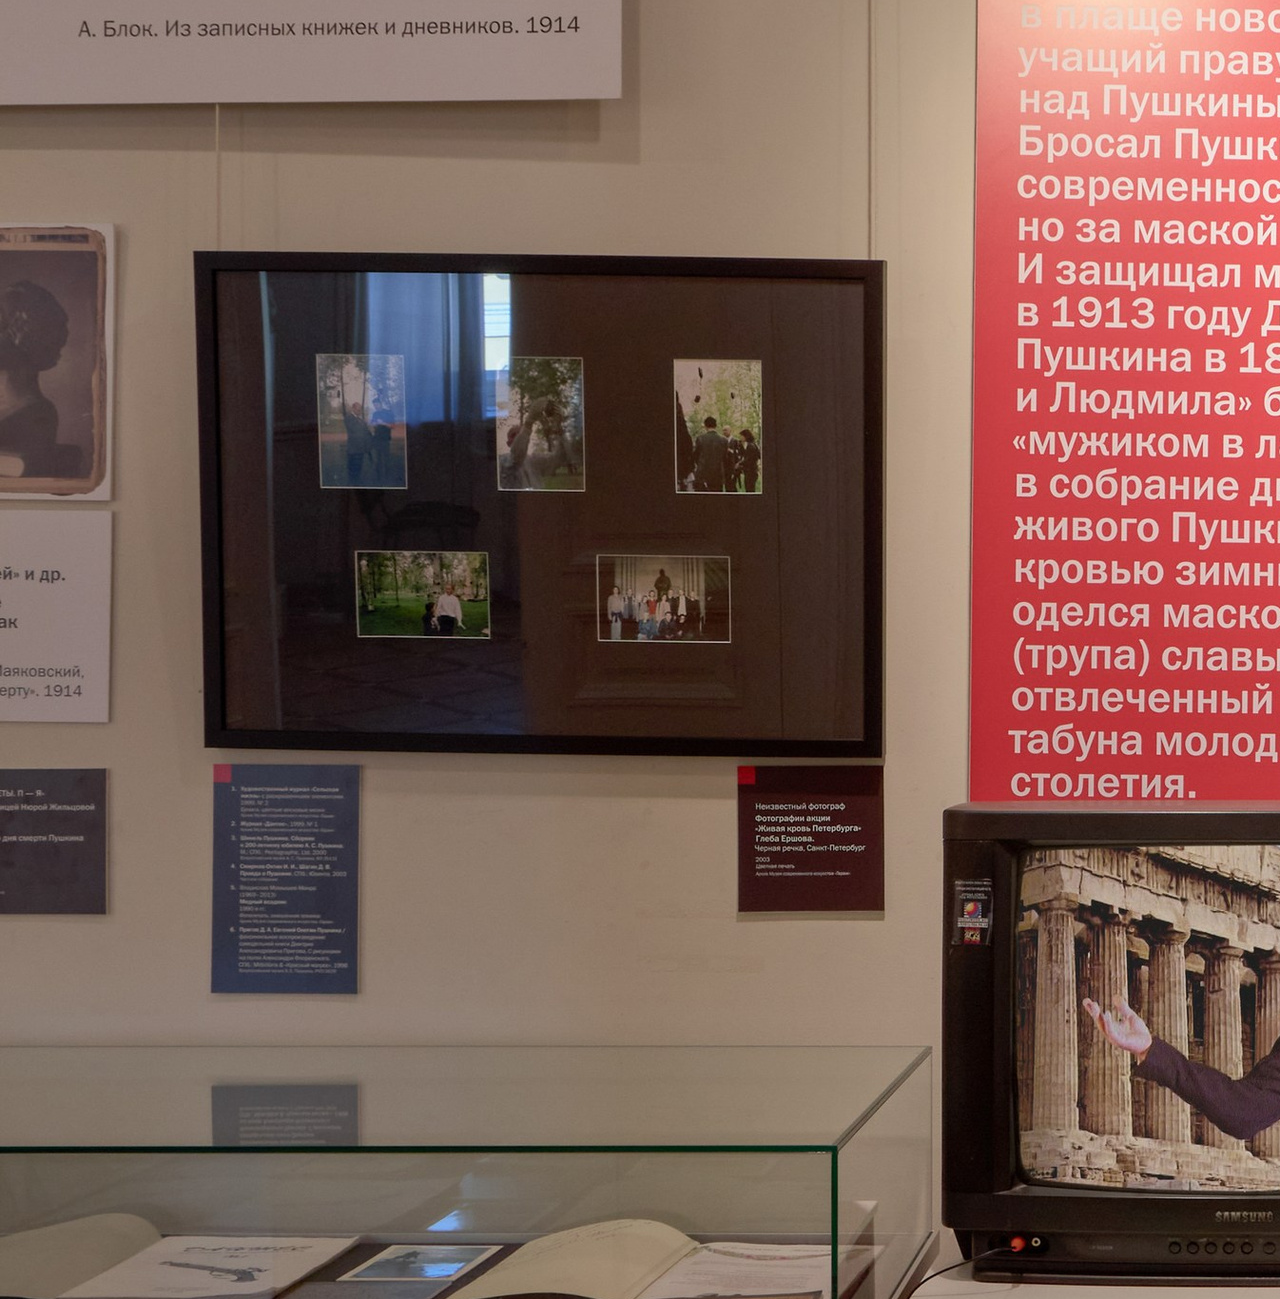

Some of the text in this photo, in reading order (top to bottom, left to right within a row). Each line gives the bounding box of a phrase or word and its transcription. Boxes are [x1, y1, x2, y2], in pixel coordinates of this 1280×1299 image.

[78, 16, 580, 38] А. Блок. Из записных книжек и дневников. 1914
[1019, 43, 1165, 77] учащий
[1021, 90, 1090, 120] над
[1020, 125, 1160, 163] Бросал
[1018, 252, 1043, 284] И
[1055, 260, 1241, 293] защищал
[1018, 303, 1039, 326] в
[1052, 296, 1155, 329] 1913
[1168, 305, 1252, 338] году
[1017, 338, 1192, 377] Пушкина
[1205, 349, 1227, 373] в
[1013, 431, 1209, 463] «мужиком
[1223, 434, 1244, 458] в
[1013, 516, 1159, 543] живого
[1015, 559, 1164, 590] кровью
[1013, 637, 1150, 677] (трупа)
[44, 684, 83, 697] 1914
[1012, 683, 1273, 714] отвлеченный
[1008, 722, 1142, 762] табуна
[1010, 772, 1196, 799] столетия.
[20, 803, 48, 811] Нюрой
[755, 802, 846, 811] Неизвестный фотограф
[755, 815, 805, 823] Фотографии
[18, 835, 47, 843] смерти
[48, 834, 84, 843] Пушкина
[1215, 1210, 1274, 1223] SAMSUNG
